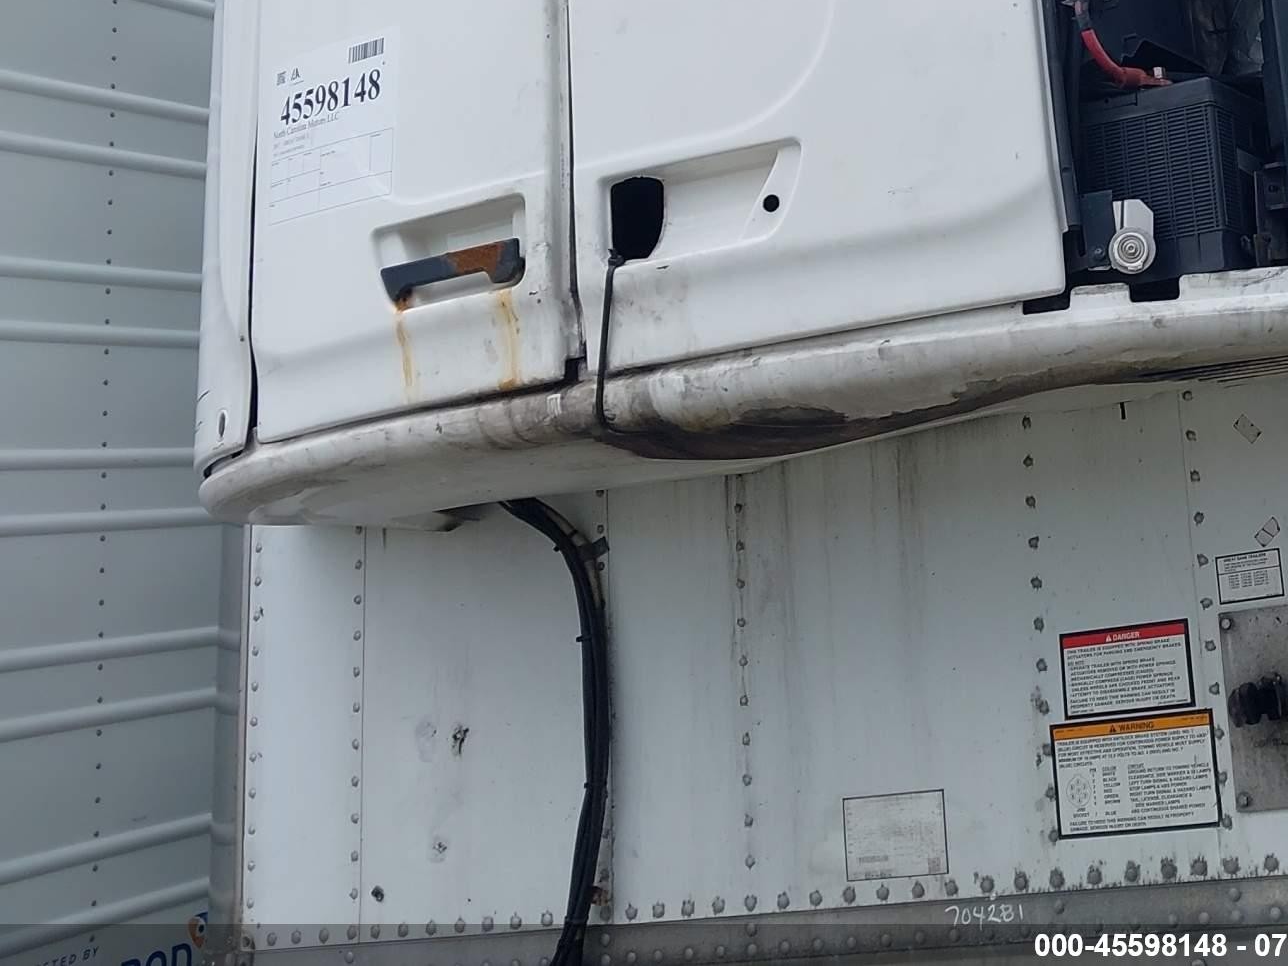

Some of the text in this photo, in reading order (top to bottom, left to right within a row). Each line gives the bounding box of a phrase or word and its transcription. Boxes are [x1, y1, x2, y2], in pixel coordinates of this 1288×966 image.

[280, 69, 381, 125] 45598148
[1112, 630, 1139, 641] DANGER
[1118, 720, 1154, 731] WARNING
[945, 904, 1024, 931] 704281
[82, 945, 100, 961] BY
